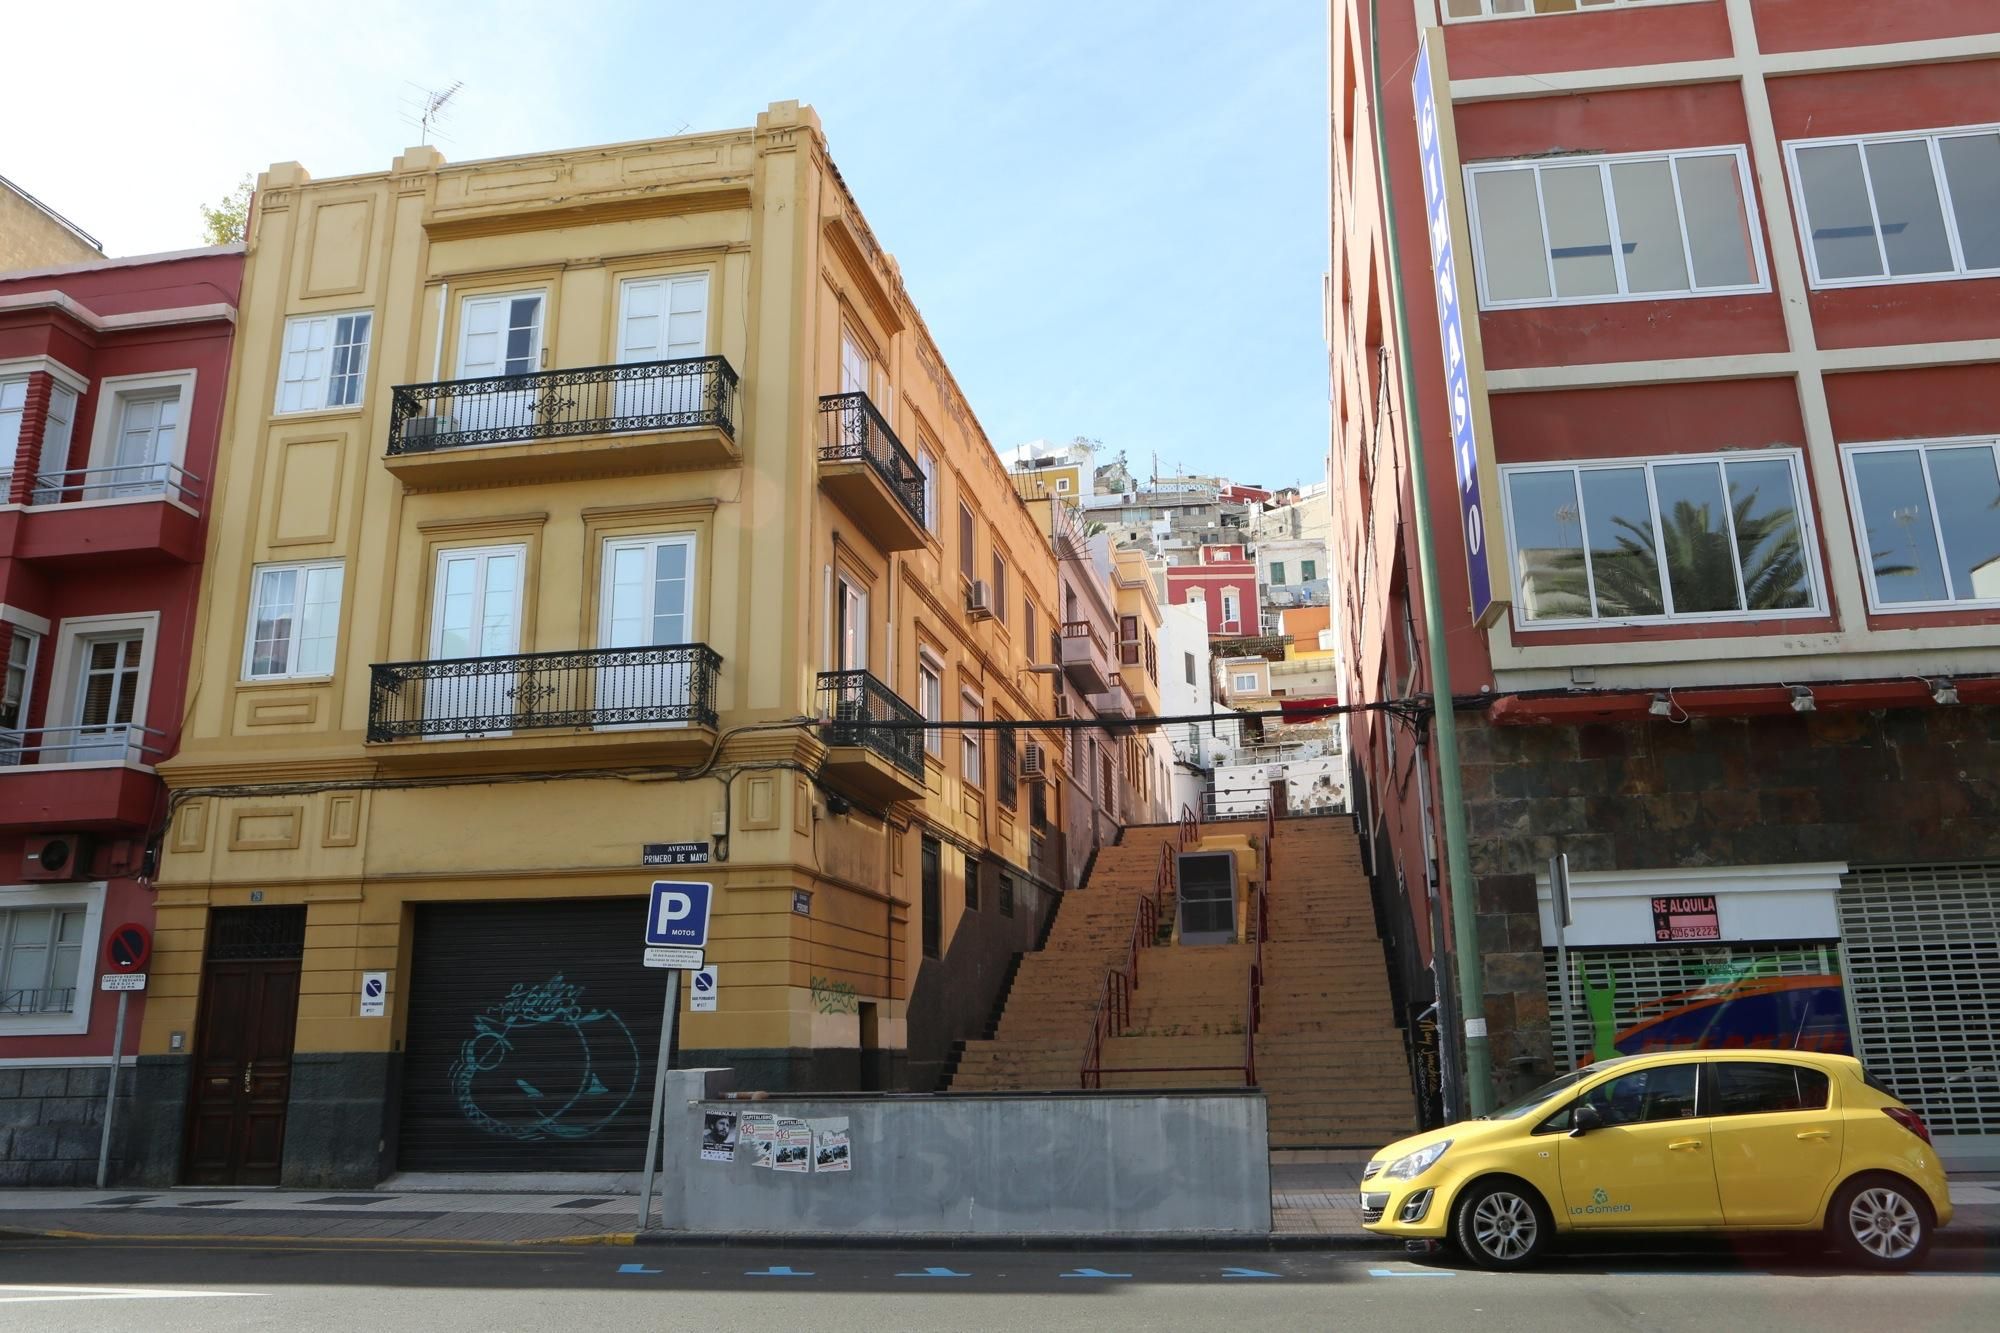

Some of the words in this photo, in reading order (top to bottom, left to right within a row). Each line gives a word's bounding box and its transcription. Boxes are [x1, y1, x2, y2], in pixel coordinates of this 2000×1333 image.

[1422, 94, 1481, 556] GIMNASIO
[644, 854, 672, 863] PRIMERO
[677, 853, 686, 862] DE
[690, 852, 708, 862] MAYO
[1653, 899, 1668, 913] SE
[1670, 898, 1715, 913] ALQUILA
[656, 892, 691, 935] P
[671, 929, 695, 937] MOTOS
[1570, 1205, 1583, 1215] La
[1585, 1204, 1631, 1214] Gomera
